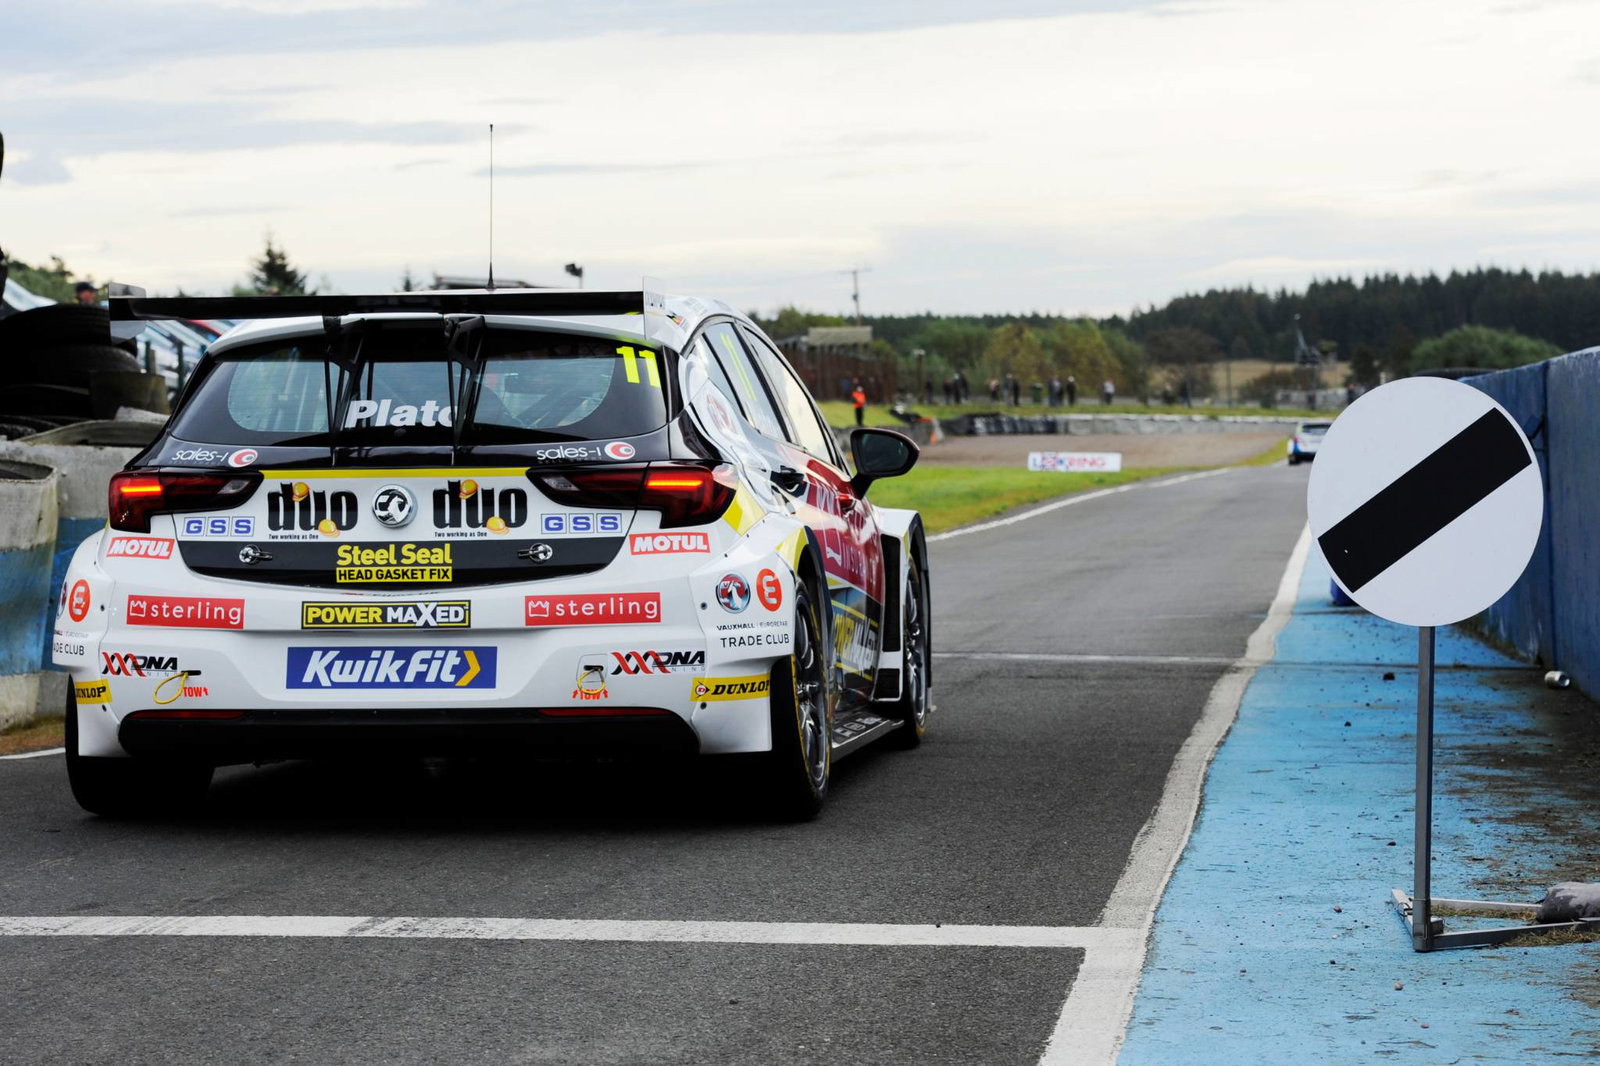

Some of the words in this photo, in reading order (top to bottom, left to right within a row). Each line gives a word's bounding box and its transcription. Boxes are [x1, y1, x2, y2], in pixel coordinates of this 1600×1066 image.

[616, 346, 661, 388] 11
[267, 482, 358, 531] duo
[433, 480, 527, 529] duo
[111, 540, 170, 556] MOTUL
[633, 535, 708, 552] MOTUL
[336, 544, 397, 566] Steel
[401, 543, 453, 565] Seal
[338, 569, 373, 580] HEAD
[375, 568, 427, 580] GASKET
[430, 568, 450, 579] FIX
[150, 601, 242, 624] sterling
[307, 607, 382, 623] POWER
[555, 598, 658, 618] sterling
[716, 623, 755, 631] VAUXHALL
[720, 635, 763, 648] TRADE
[765, 633, 790, 645] CLUB
[64, 643, 85, 656] CLUB
[183, 687, 202, 697] TOW
